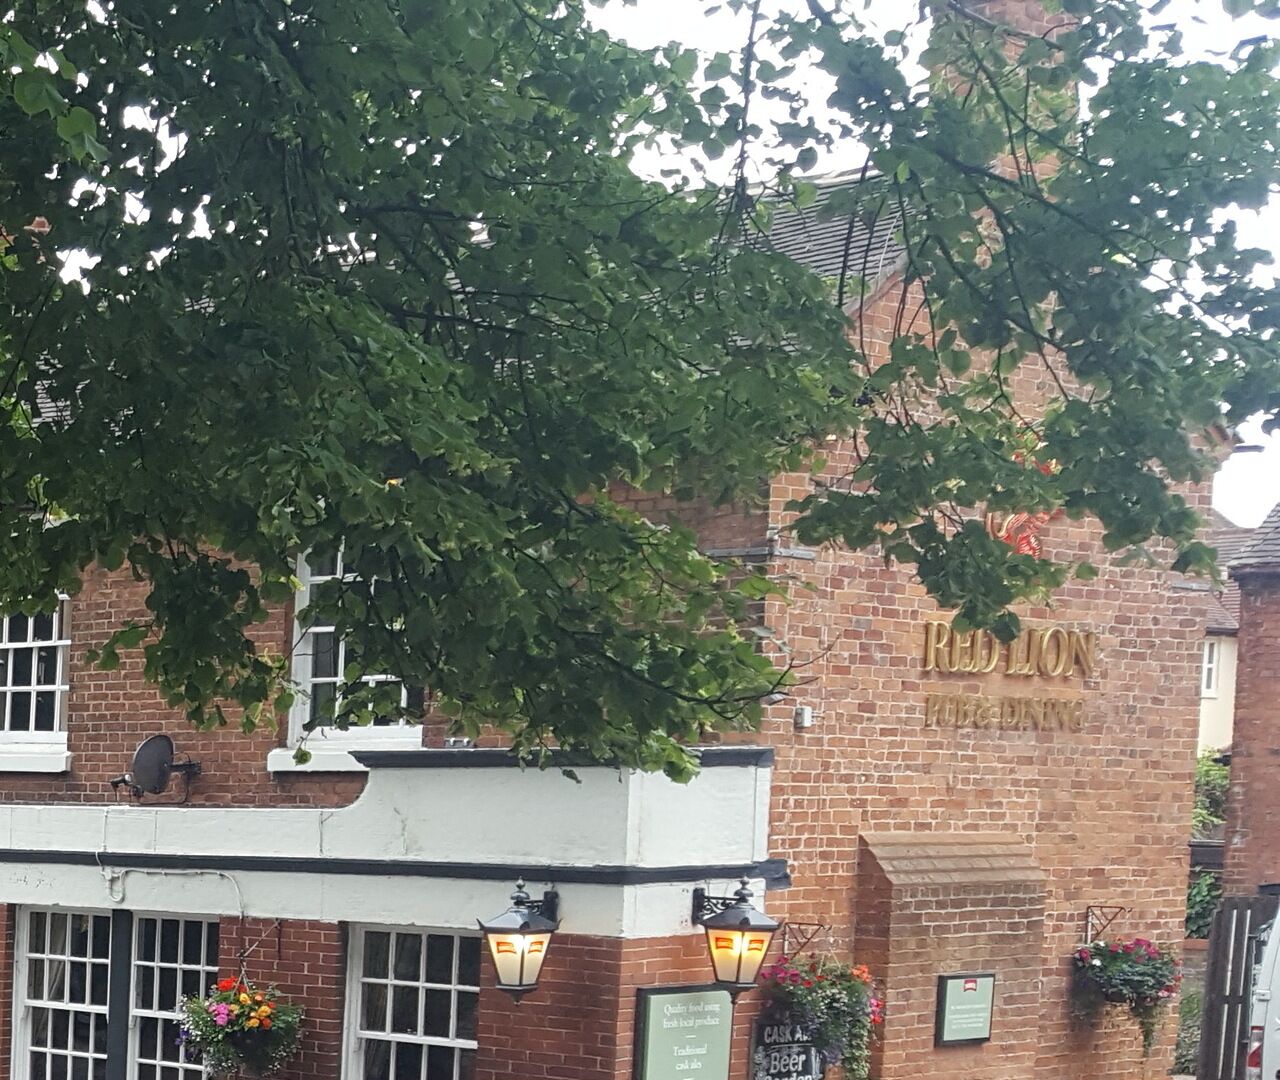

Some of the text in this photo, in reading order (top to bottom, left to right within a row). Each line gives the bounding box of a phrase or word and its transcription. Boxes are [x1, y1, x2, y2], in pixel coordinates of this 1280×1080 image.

[924, 620, 1097, 678] RED LION
[764, 1025, 793, 1043] CASK
[770, 1052, 807, 1073] Beer
